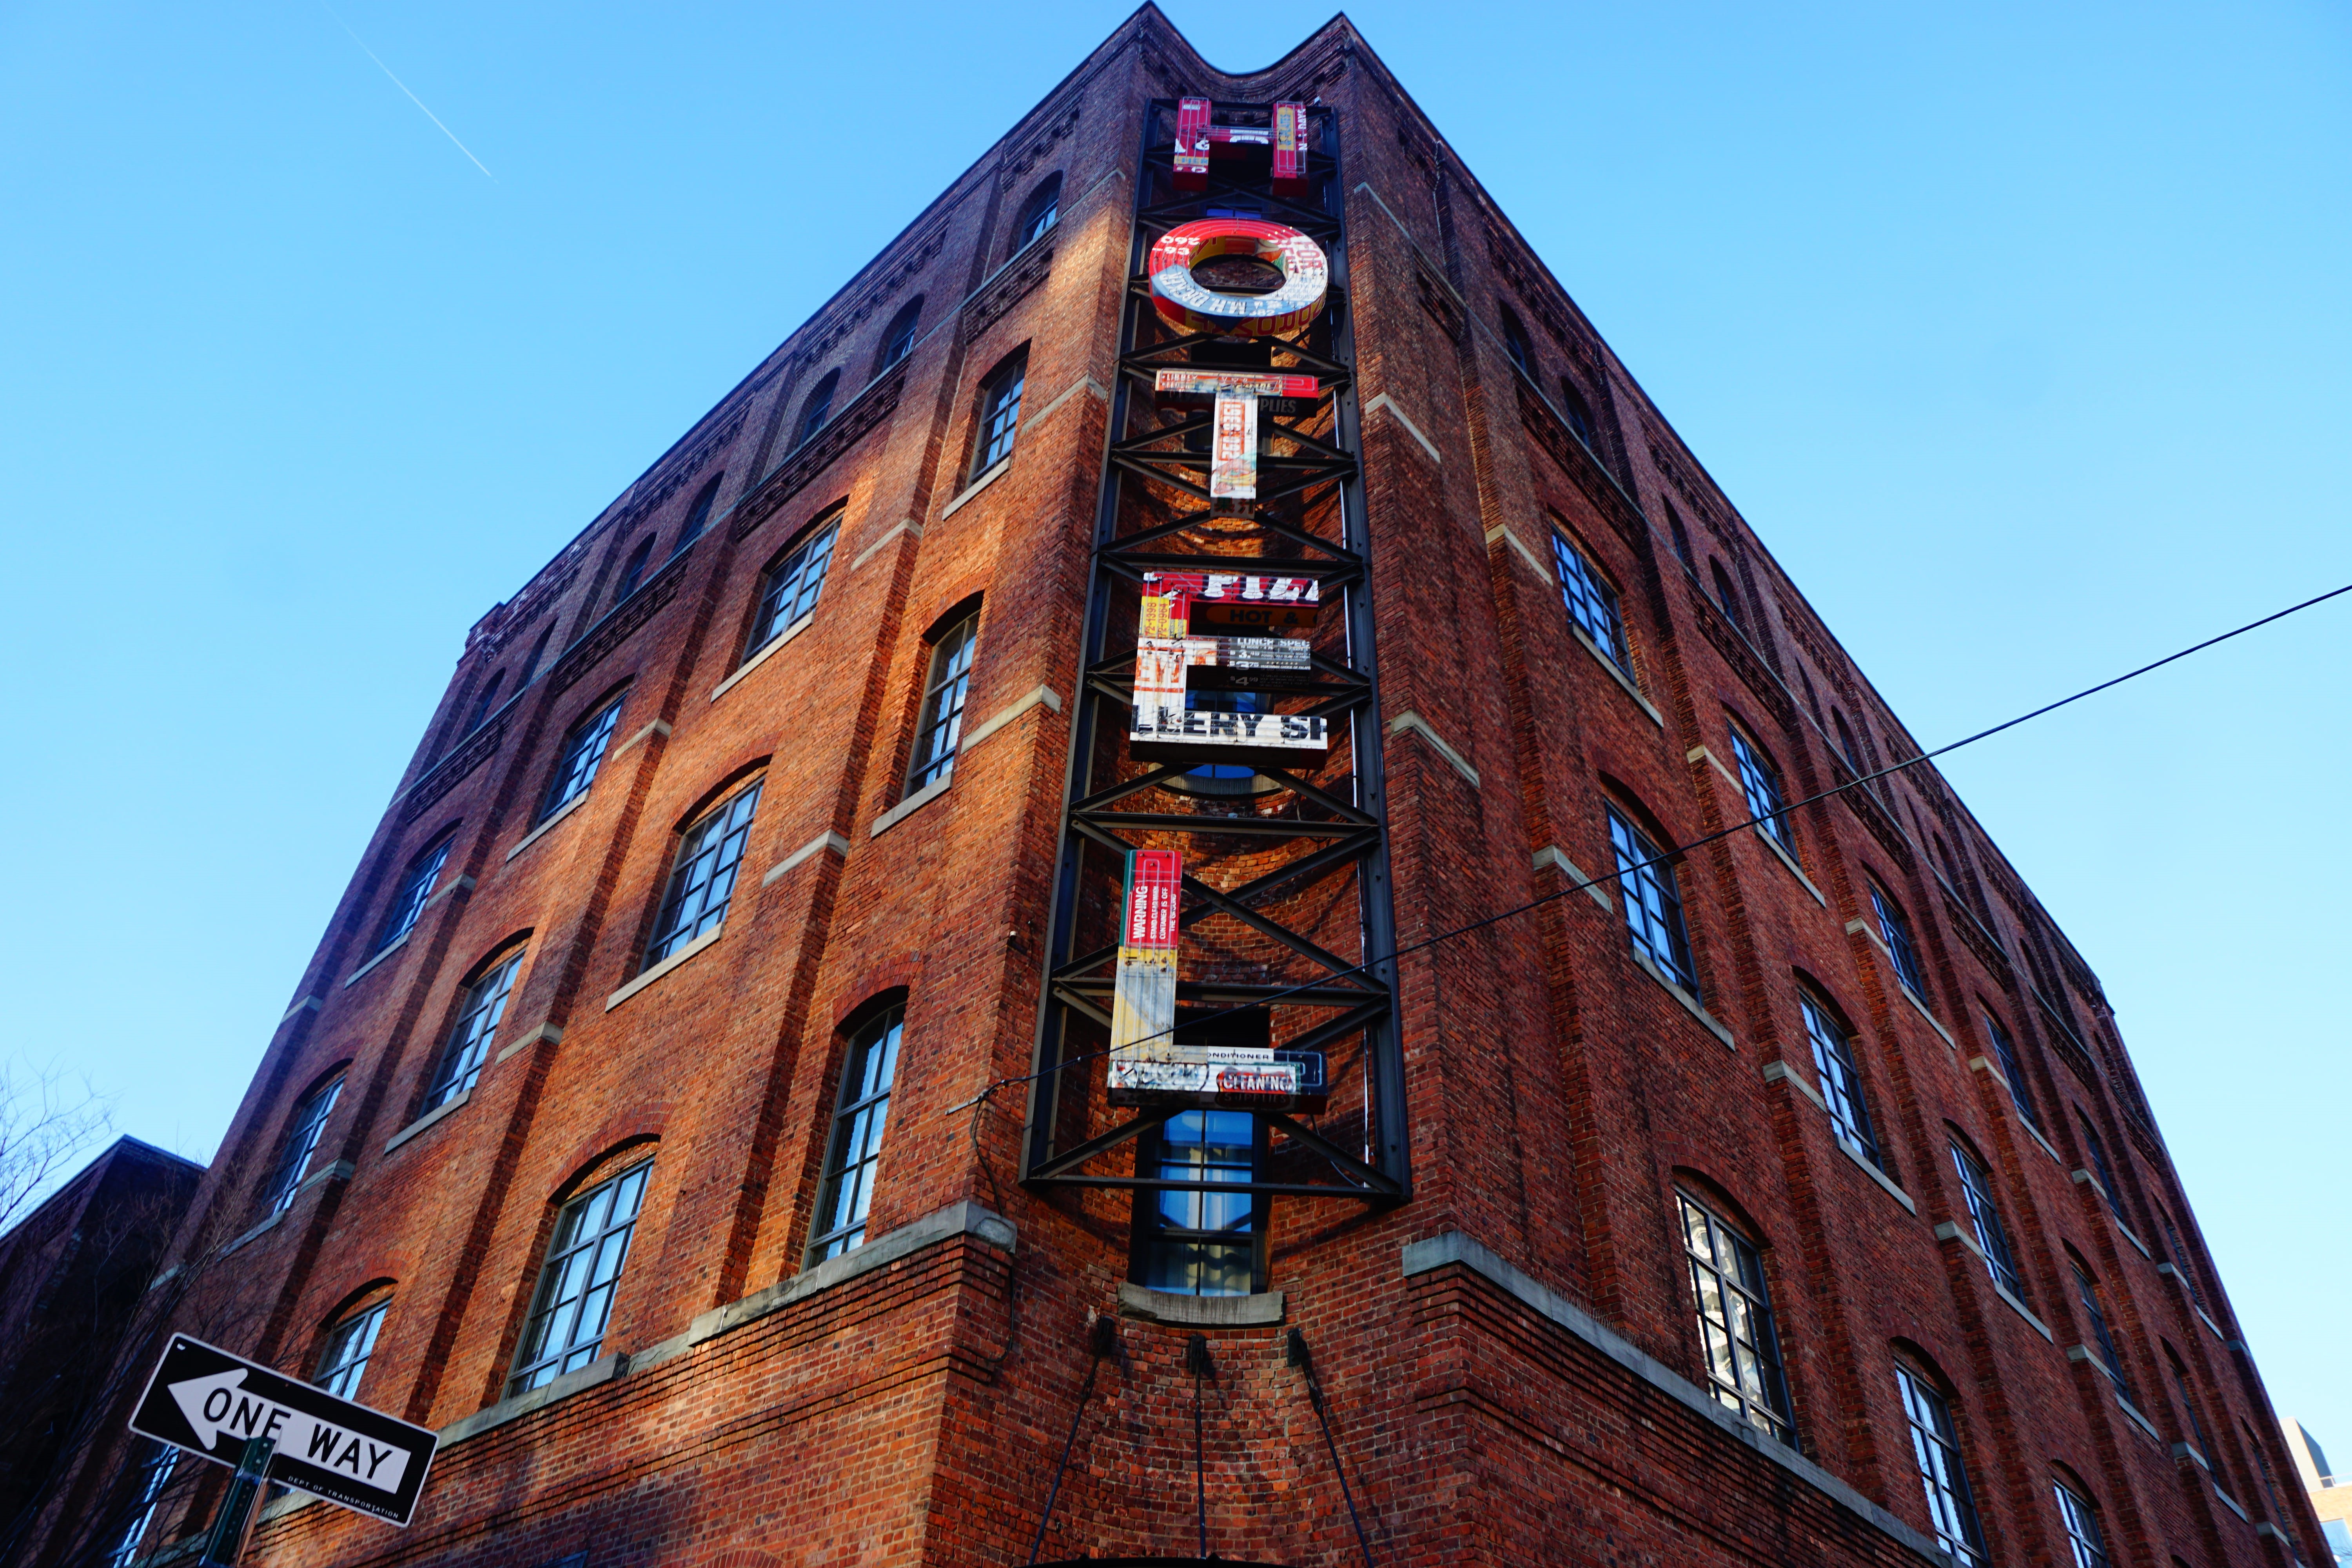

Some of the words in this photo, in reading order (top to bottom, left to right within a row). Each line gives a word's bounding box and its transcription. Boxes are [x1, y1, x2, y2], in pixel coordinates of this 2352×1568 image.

[1294, 242, 1323, 269] FOR
[1257, 397, 1297, 413] PLIES
[1108, 97, 1328, 1110] HOTEL
[1230, 610, 1273, 623] HOT
[1283, 612, 1299, 624] &
[1237, 637, 1274, 646] LUNCH
[1133, 886, 1148, 939] WARNING
[1223, 1074, 1293, 1091] CLEANING
[203, 1387, 291, 1439] ONE
[307, 1423, 393, 1480] WAY
[288, 1475, 310, 1488] DEPT
[328, 1489, 399, 1519] TRANSPORTATION
